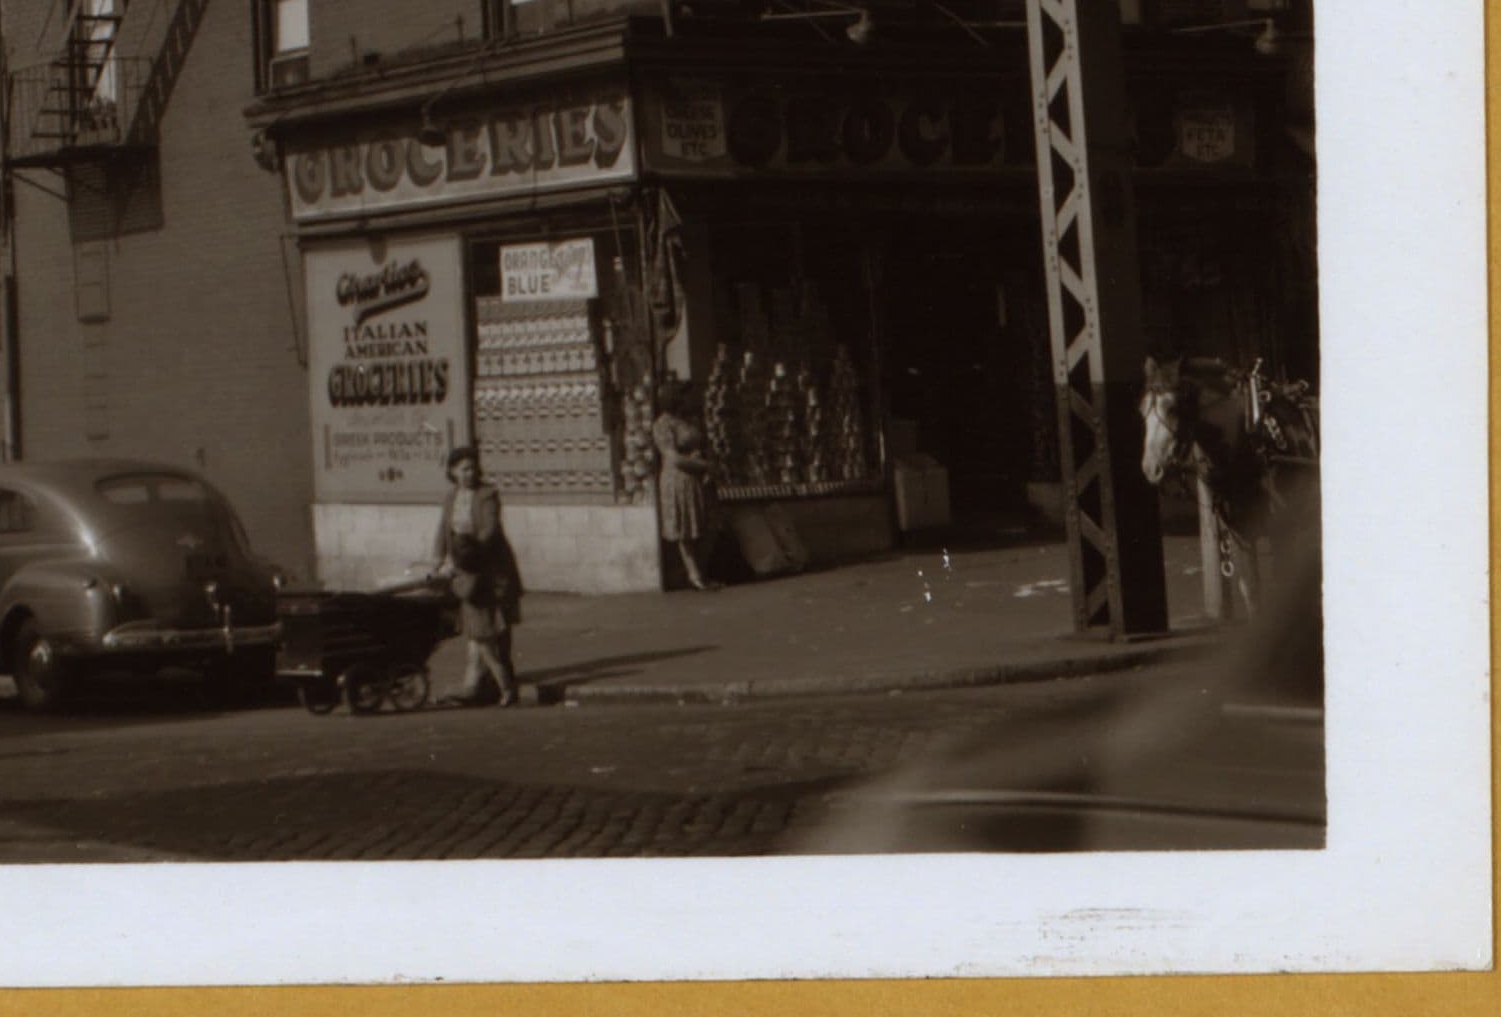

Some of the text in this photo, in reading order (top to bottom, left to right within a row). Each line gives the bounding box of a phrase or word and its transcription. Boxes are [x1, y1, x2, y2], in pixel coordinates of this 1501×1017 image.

[293, 94, 628, 204] GROCERIES
[508, 274, 550, 295] BLUE
[343, 321, 428, 342] ITALIAN
[344, 340, 429, 359] AMERICAN
[327, 359, 450, 408] GROCERIES
